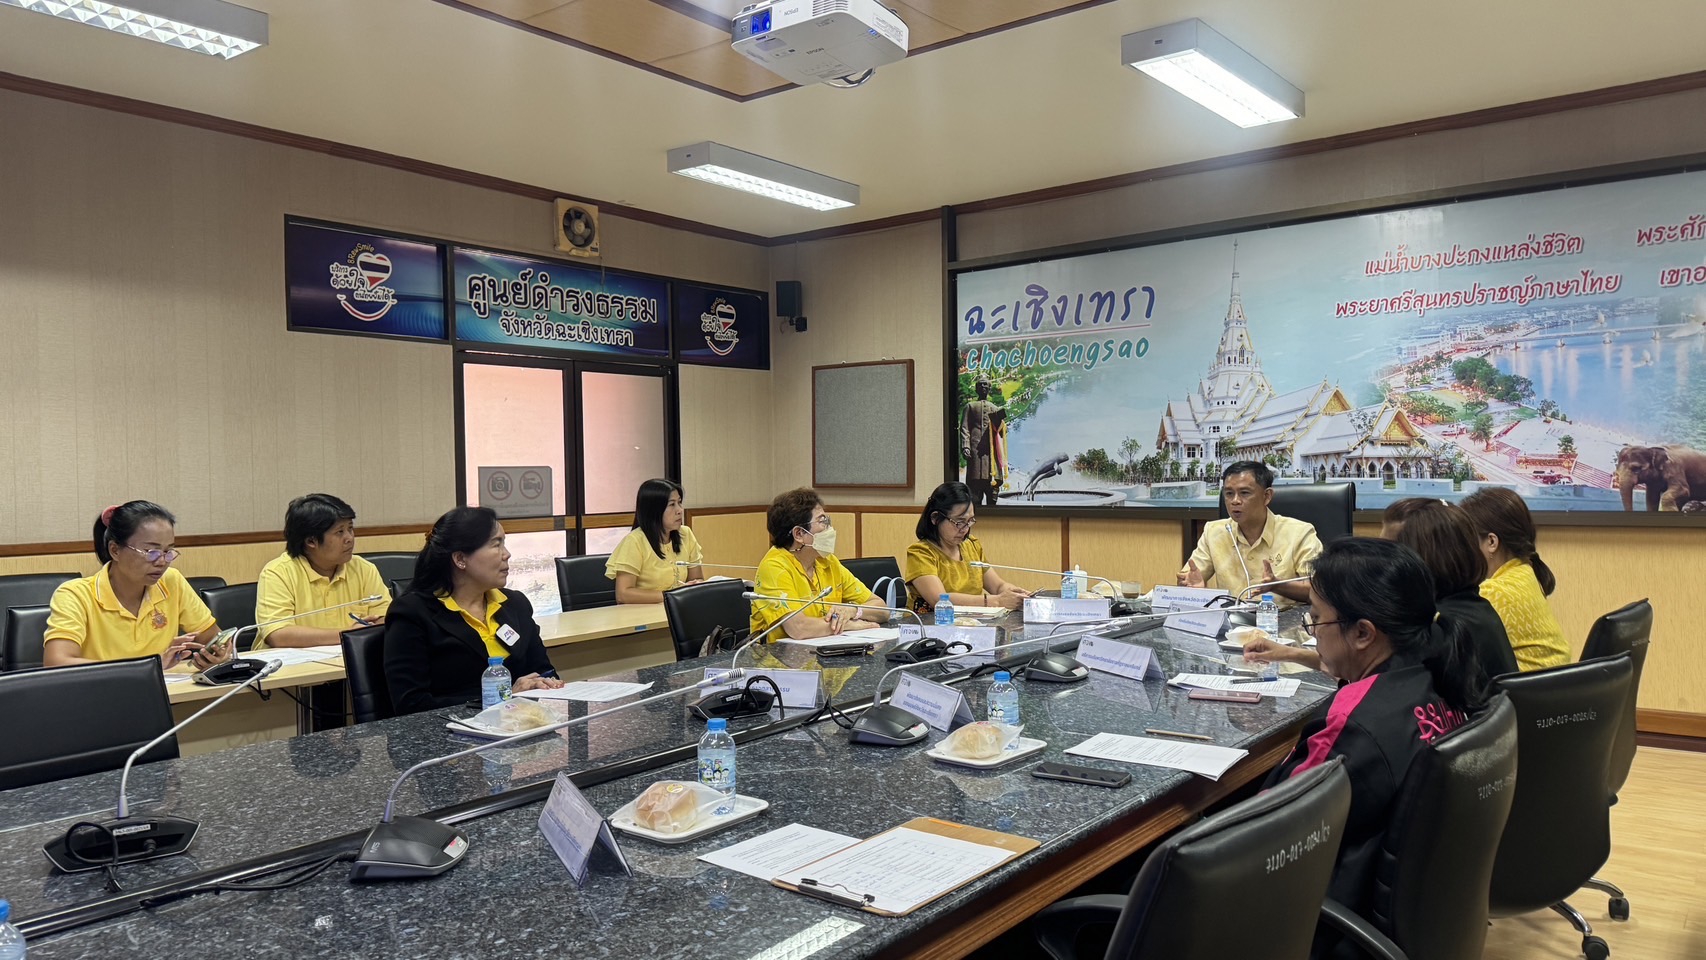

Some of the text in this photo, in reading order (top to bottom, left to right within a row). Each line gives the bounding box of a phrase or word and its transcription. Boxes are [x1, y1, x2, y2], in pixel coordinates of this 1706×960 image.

[1364, 232, 1583, 276] แม่น้ำบางปะกงแหล่งชีวิต
[467, 268, 658, 322] ศูนย์ดำรงธรรม
[964, 283, 1156, 336] ฉะเชิงเทรา
[1335, 269, 1622, 317] พระยาศรีสุนทรปราชญ์ภาษาไทย
[500, 310, 634, 347] จังหวัดฉะเชิงเทรา
[967, 336, 1150, 371] chachoengsao
